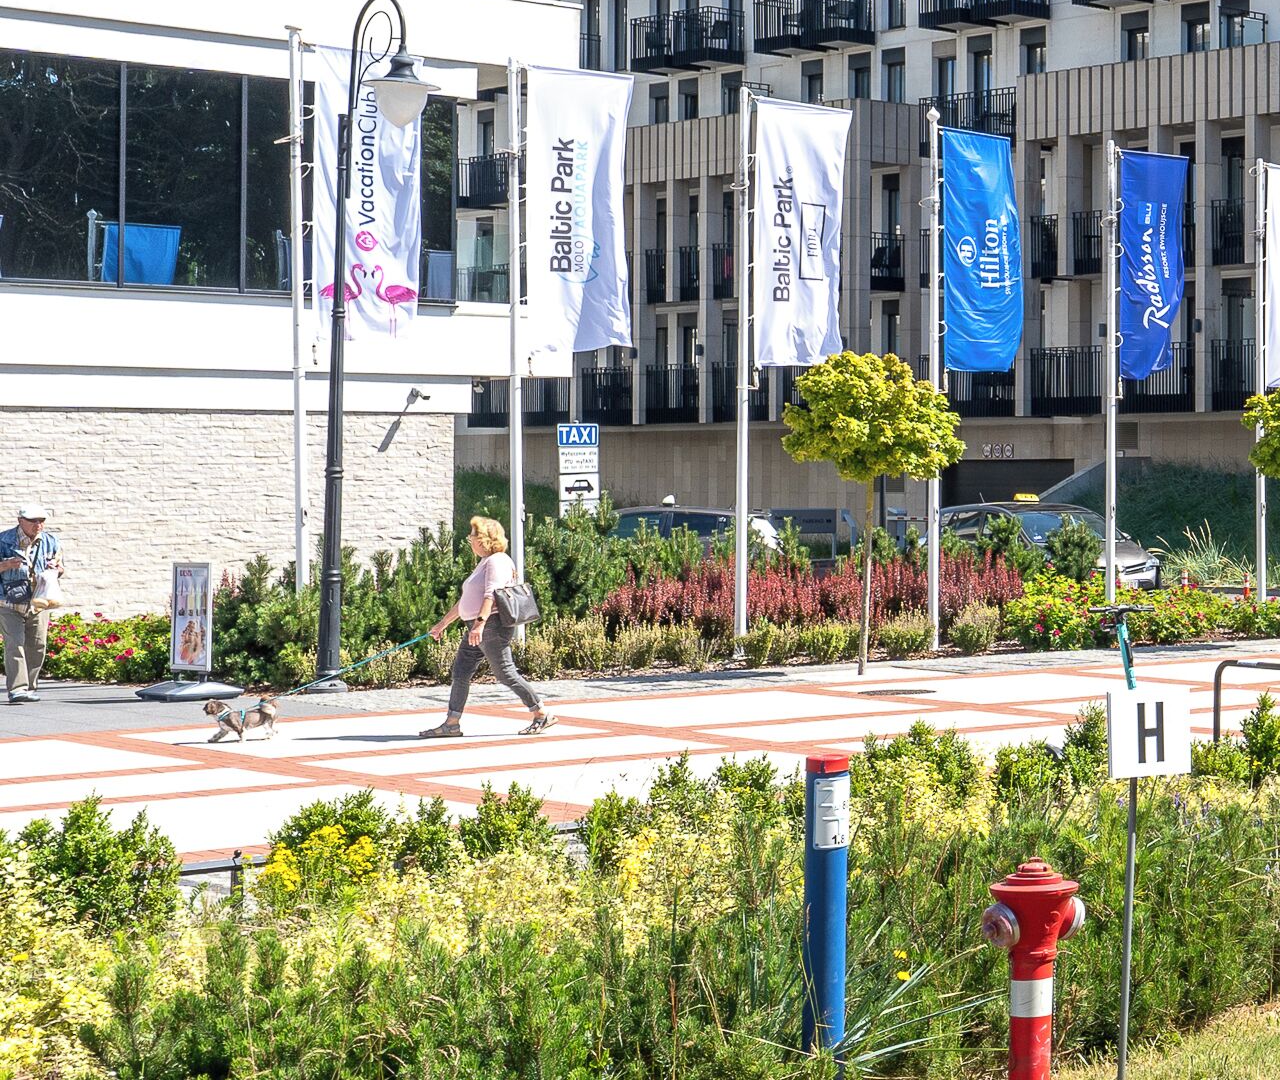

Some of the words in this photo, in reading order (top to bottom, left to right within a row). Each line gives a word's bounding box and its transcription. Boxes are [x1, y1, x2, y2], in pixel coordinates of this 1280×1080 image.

[550, 137, 575, 193] Park
[574, 140, 589, 230] AQUAPARK
[550, 200, 573, 273] Baltic
[1144, 203, 1153, 225] BLU
[574, 240, 585, 273] MOLO
[773, 234, 791, 302] Baltic
[980, 219, 1000, 289] Hilton
[1136, 227, 1171, 329] Radisson
[559, 426, 595, 443] TAXI
[1136, 701, 1165, 764] H
